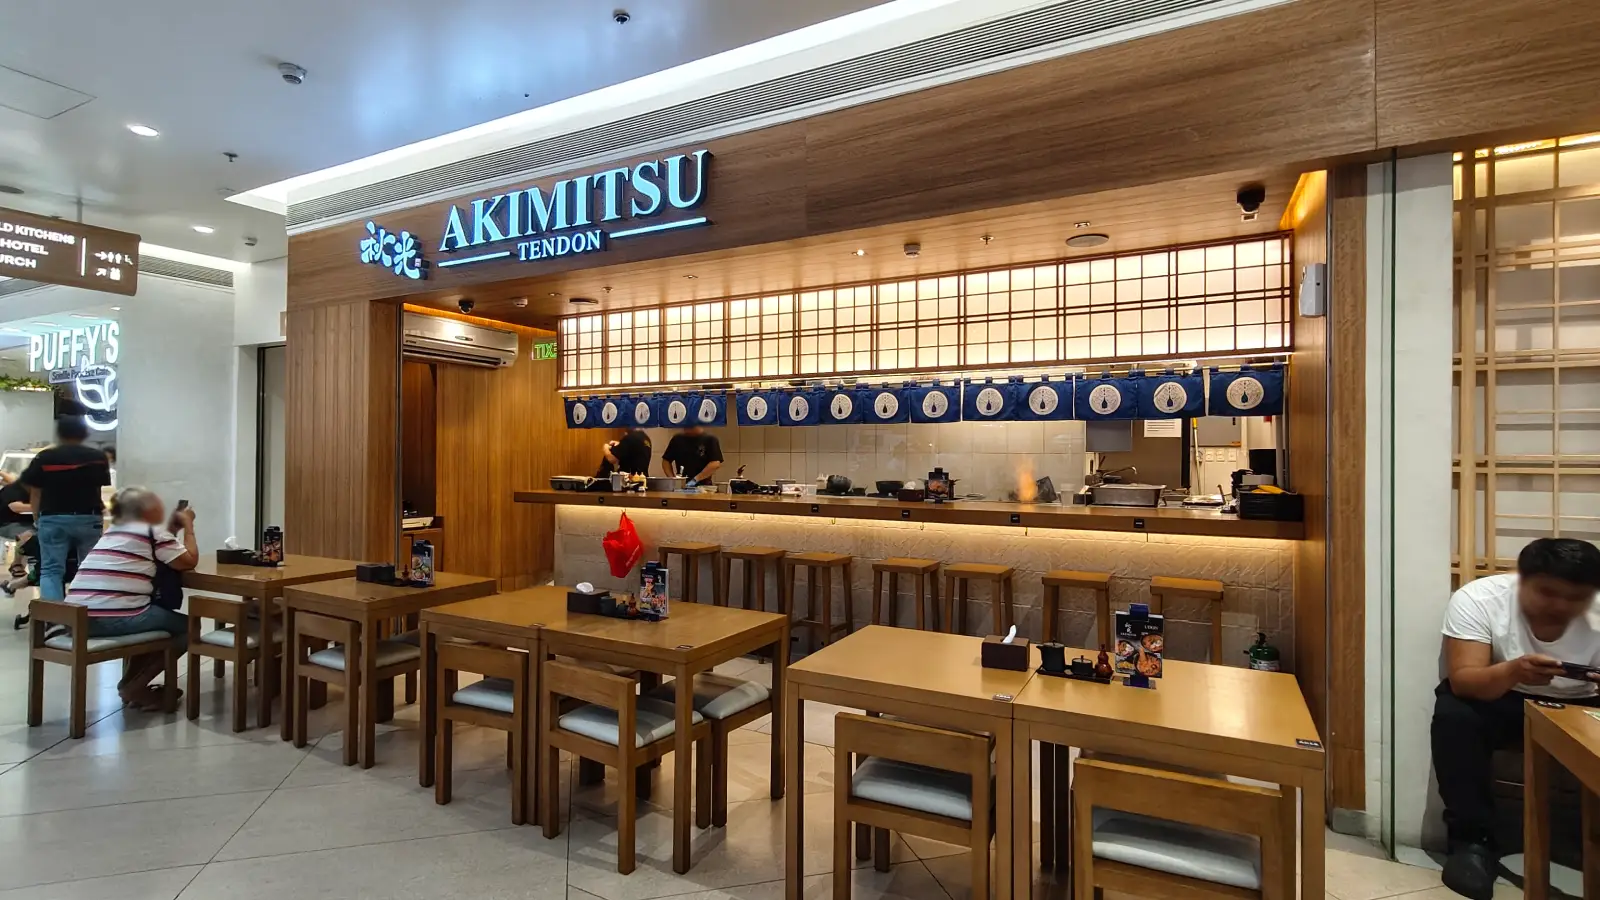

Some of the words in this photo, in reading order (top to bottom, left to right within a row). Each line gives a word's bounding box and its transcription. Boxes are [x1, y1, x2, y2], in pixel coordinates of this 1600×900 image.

[439, 149, 709, 252] AKIMITSU
[0, 238, 49, 255] HOTEL
[15, 225, 75, 245] KITCHENS
[360, 221, 420, 279] 秋光
[517, 230, 601, 261] TENDON
[29, 320, 120, 373] PUFFY'S
